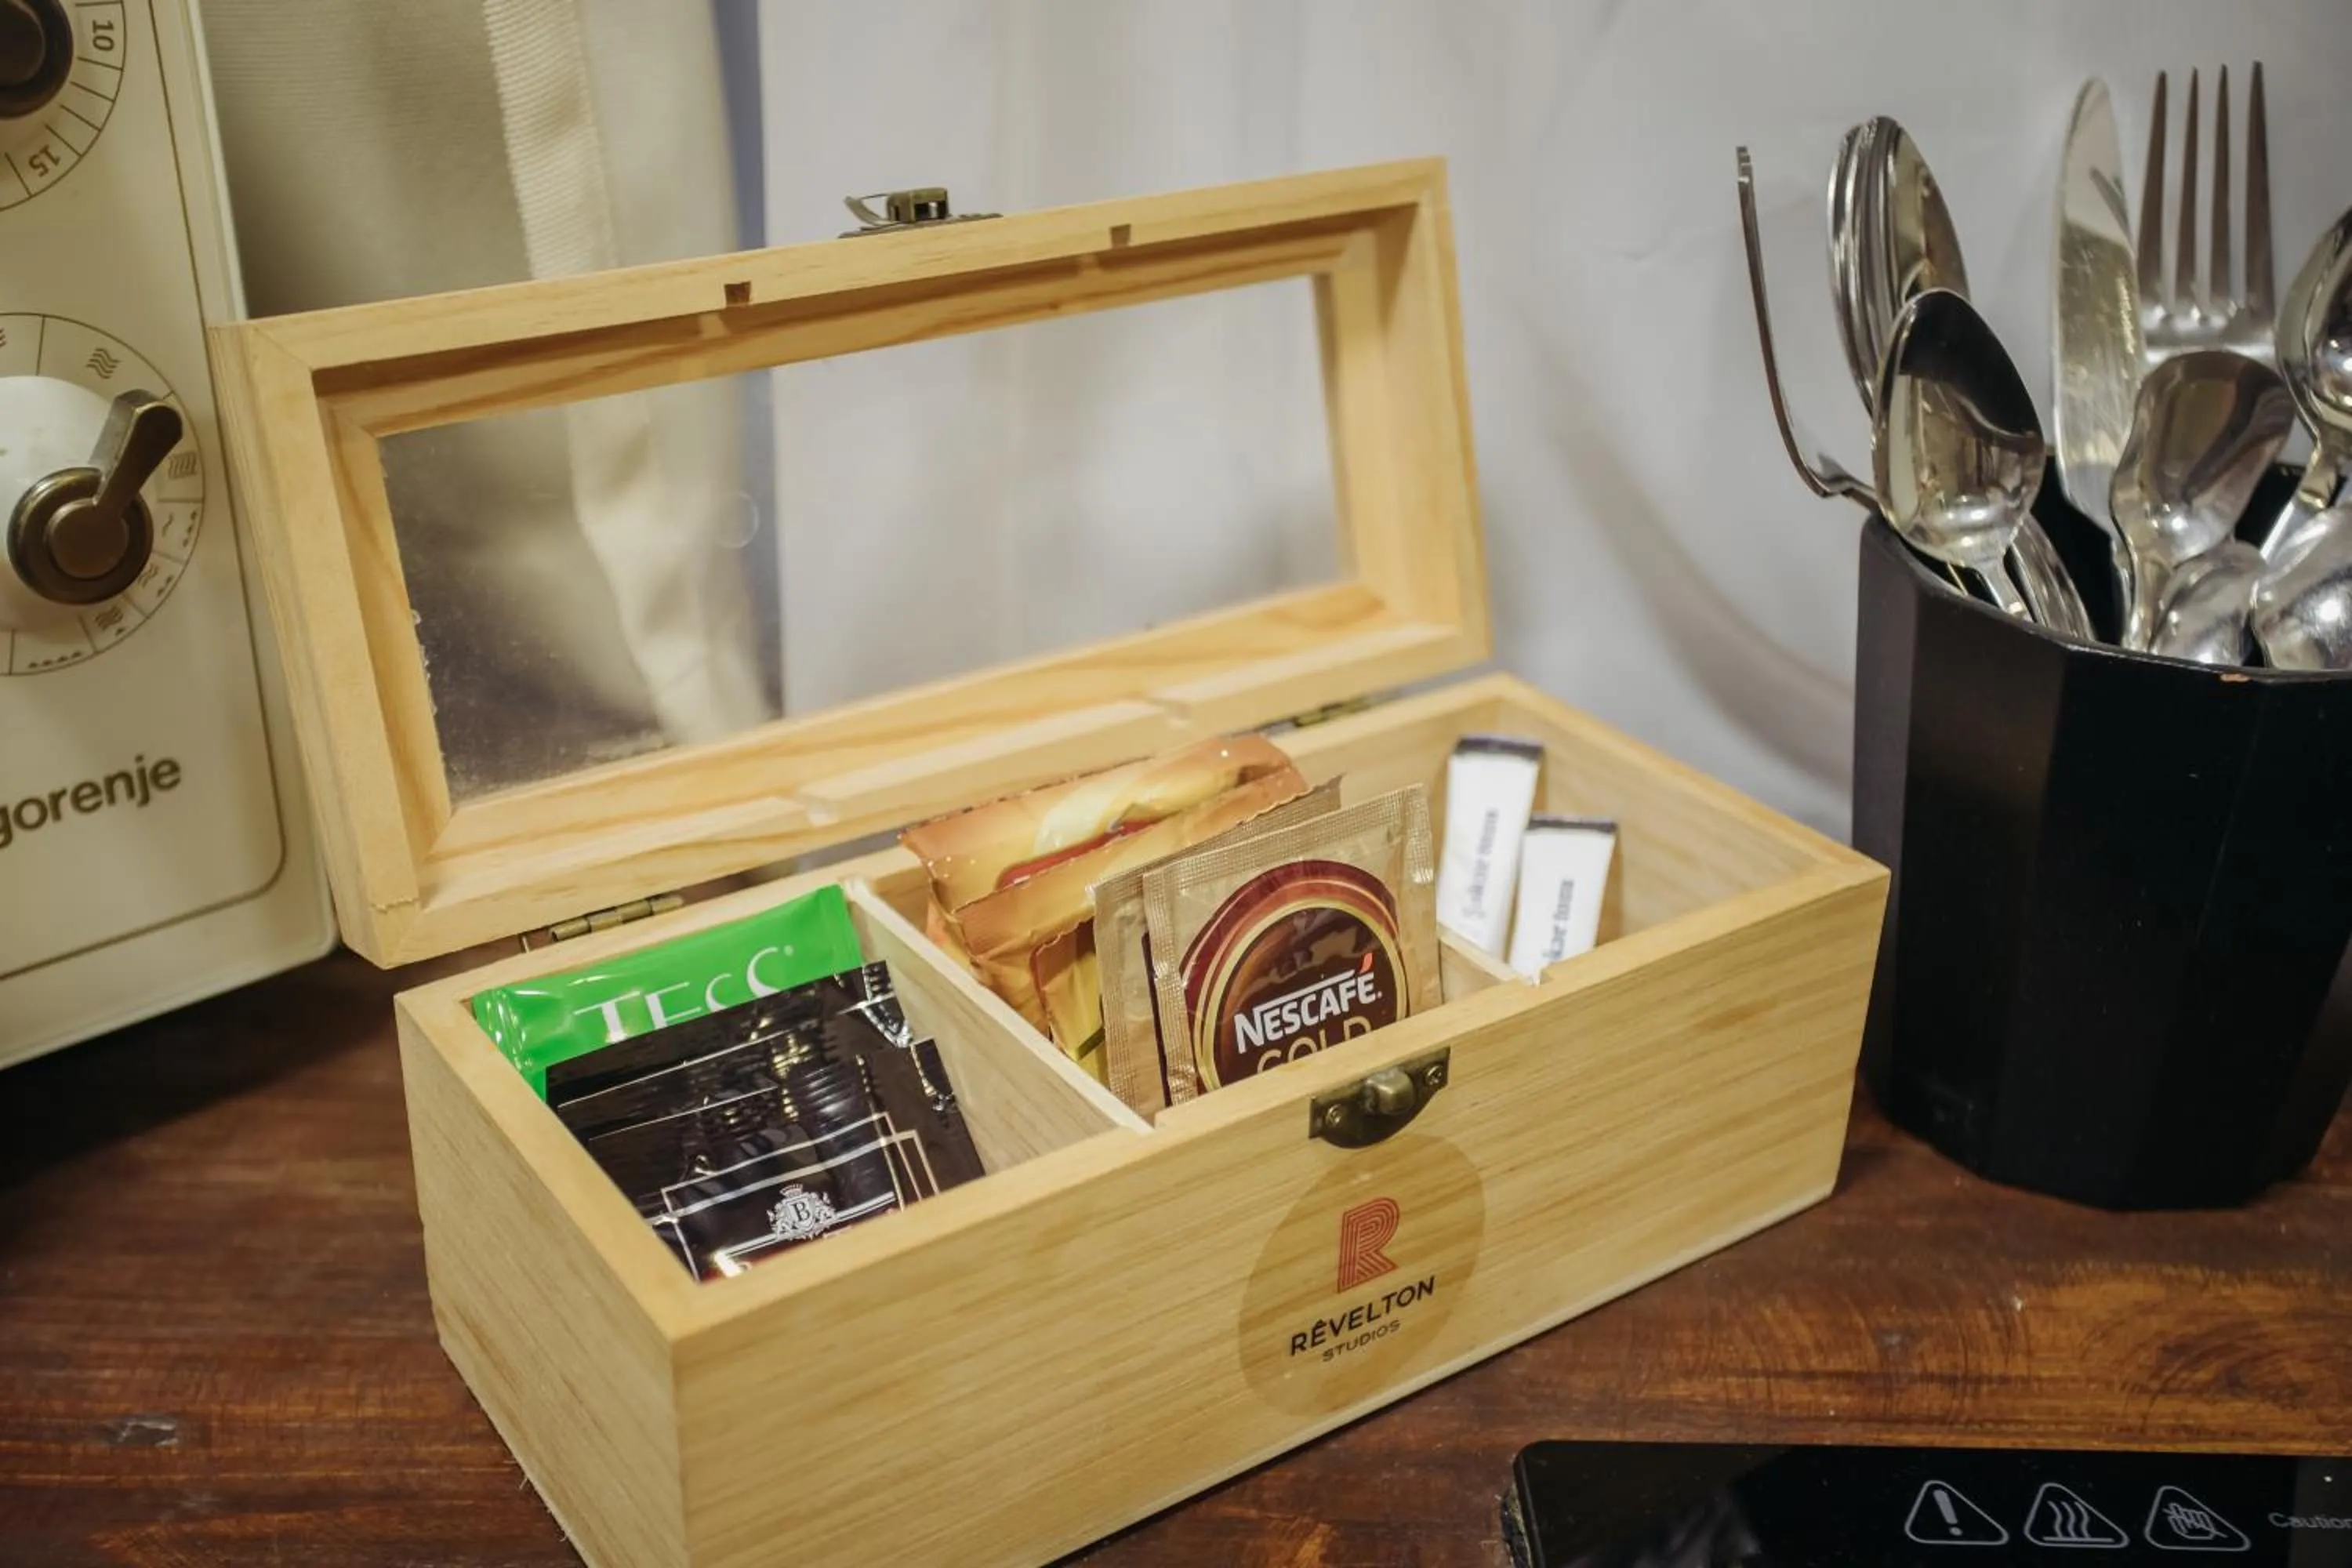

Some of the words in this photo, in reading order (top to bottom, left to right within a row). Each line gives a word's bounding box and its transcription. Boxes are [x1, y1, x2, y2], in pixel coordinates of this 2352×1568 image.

[92, 20, 114, 52] 10
[28, 144, 60, 177] 15
[1338, 1196, 1400, 1294] R
[1322, 1319, 1402, 1363] STUDIOS
